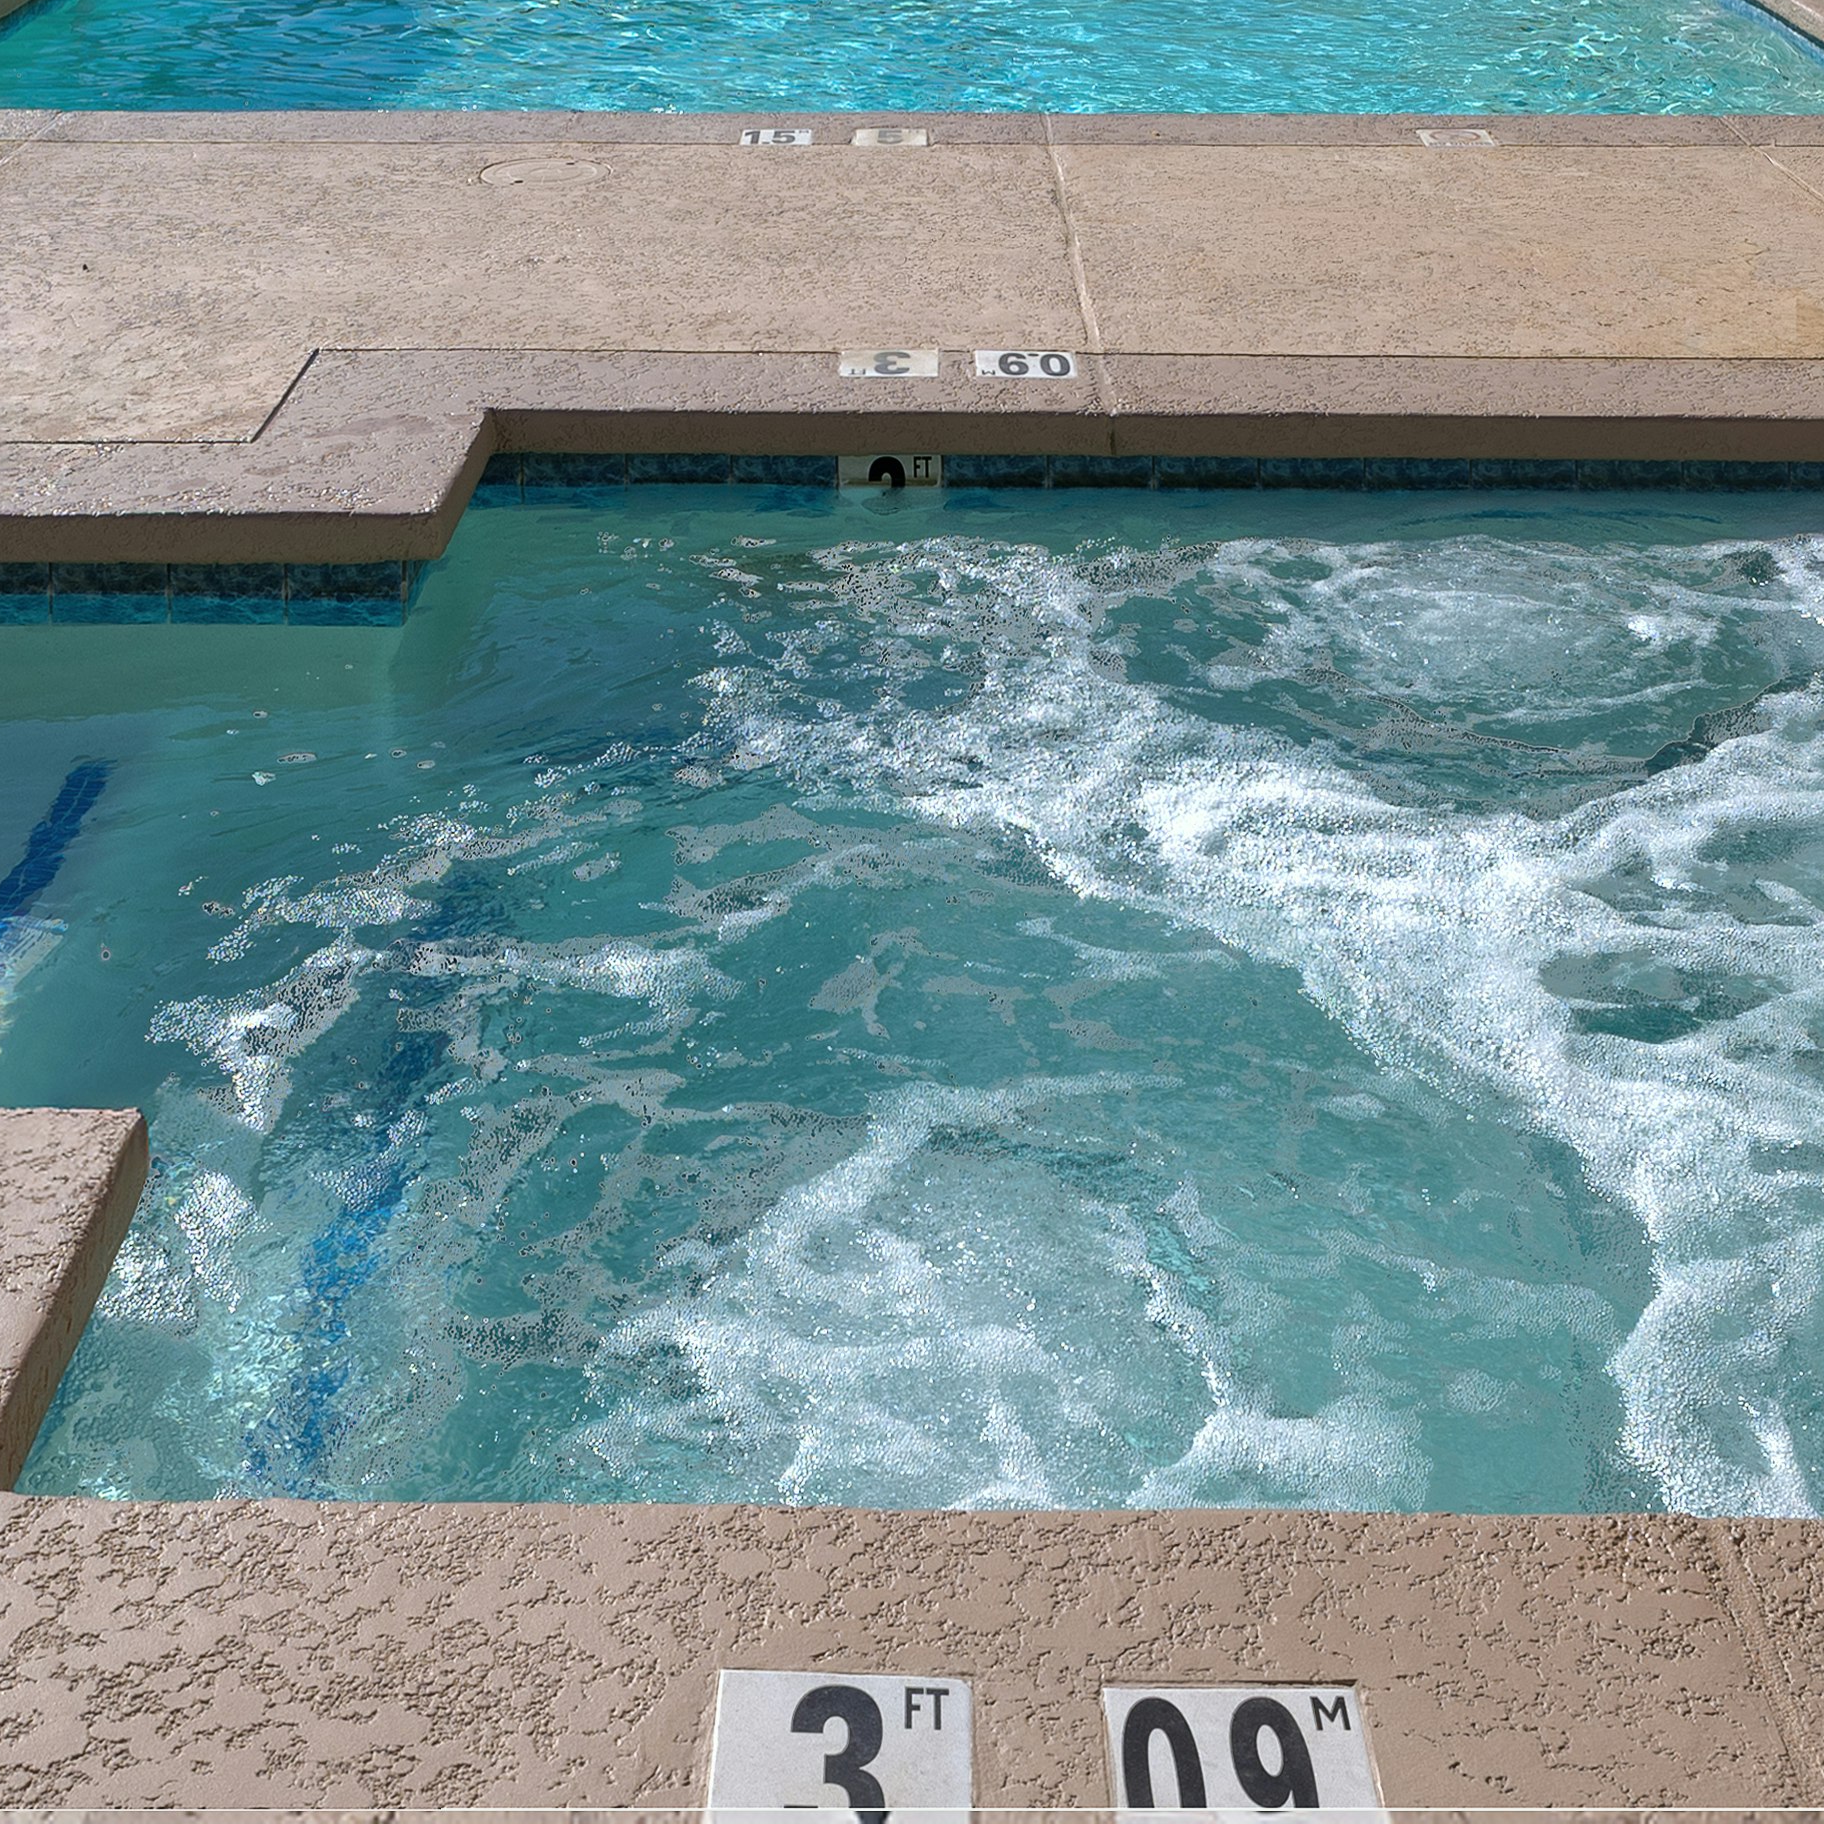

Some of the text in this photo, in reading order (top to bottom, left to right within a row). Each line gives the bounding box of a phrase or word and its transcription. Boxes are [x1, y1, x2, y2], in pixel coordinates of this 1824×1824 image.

[745, 130, 796, 145] 1.5
[877, 129, 904, 145] 5
[873, 351, 911, 375] 3
[998, 352, 1071, 377] 0.9
[913, 456, 932, 479] FT
[1309, 1695, 1352, 1731] M
[784, 1684, 950, 1823] 3 FT
